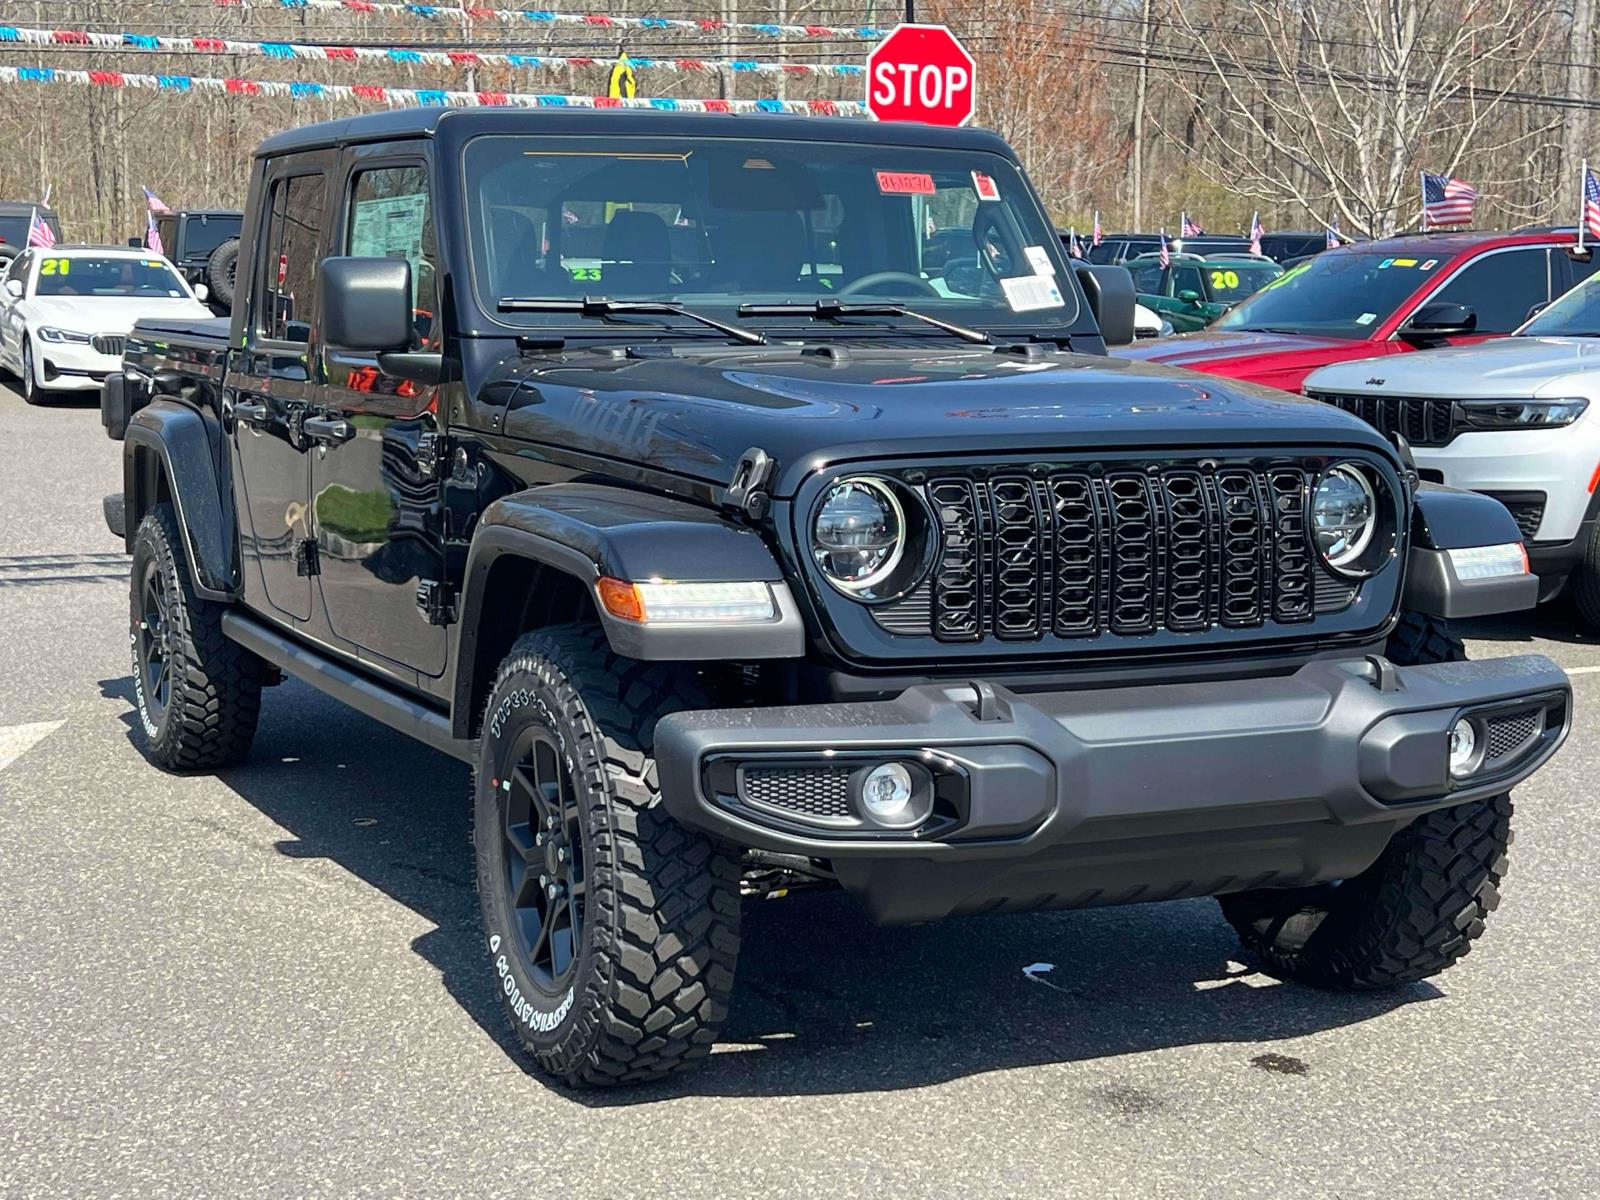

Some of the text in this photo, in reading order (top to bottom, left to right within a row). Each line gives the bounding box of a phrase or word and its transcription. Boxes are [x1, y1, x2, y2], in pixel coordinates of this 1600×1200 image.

[873, 61, 969, 109] STOP
[40, 258, 71, 276] 21
[571, 267, 602, 282] 23
[1211, 271, 1239, 289] 20
